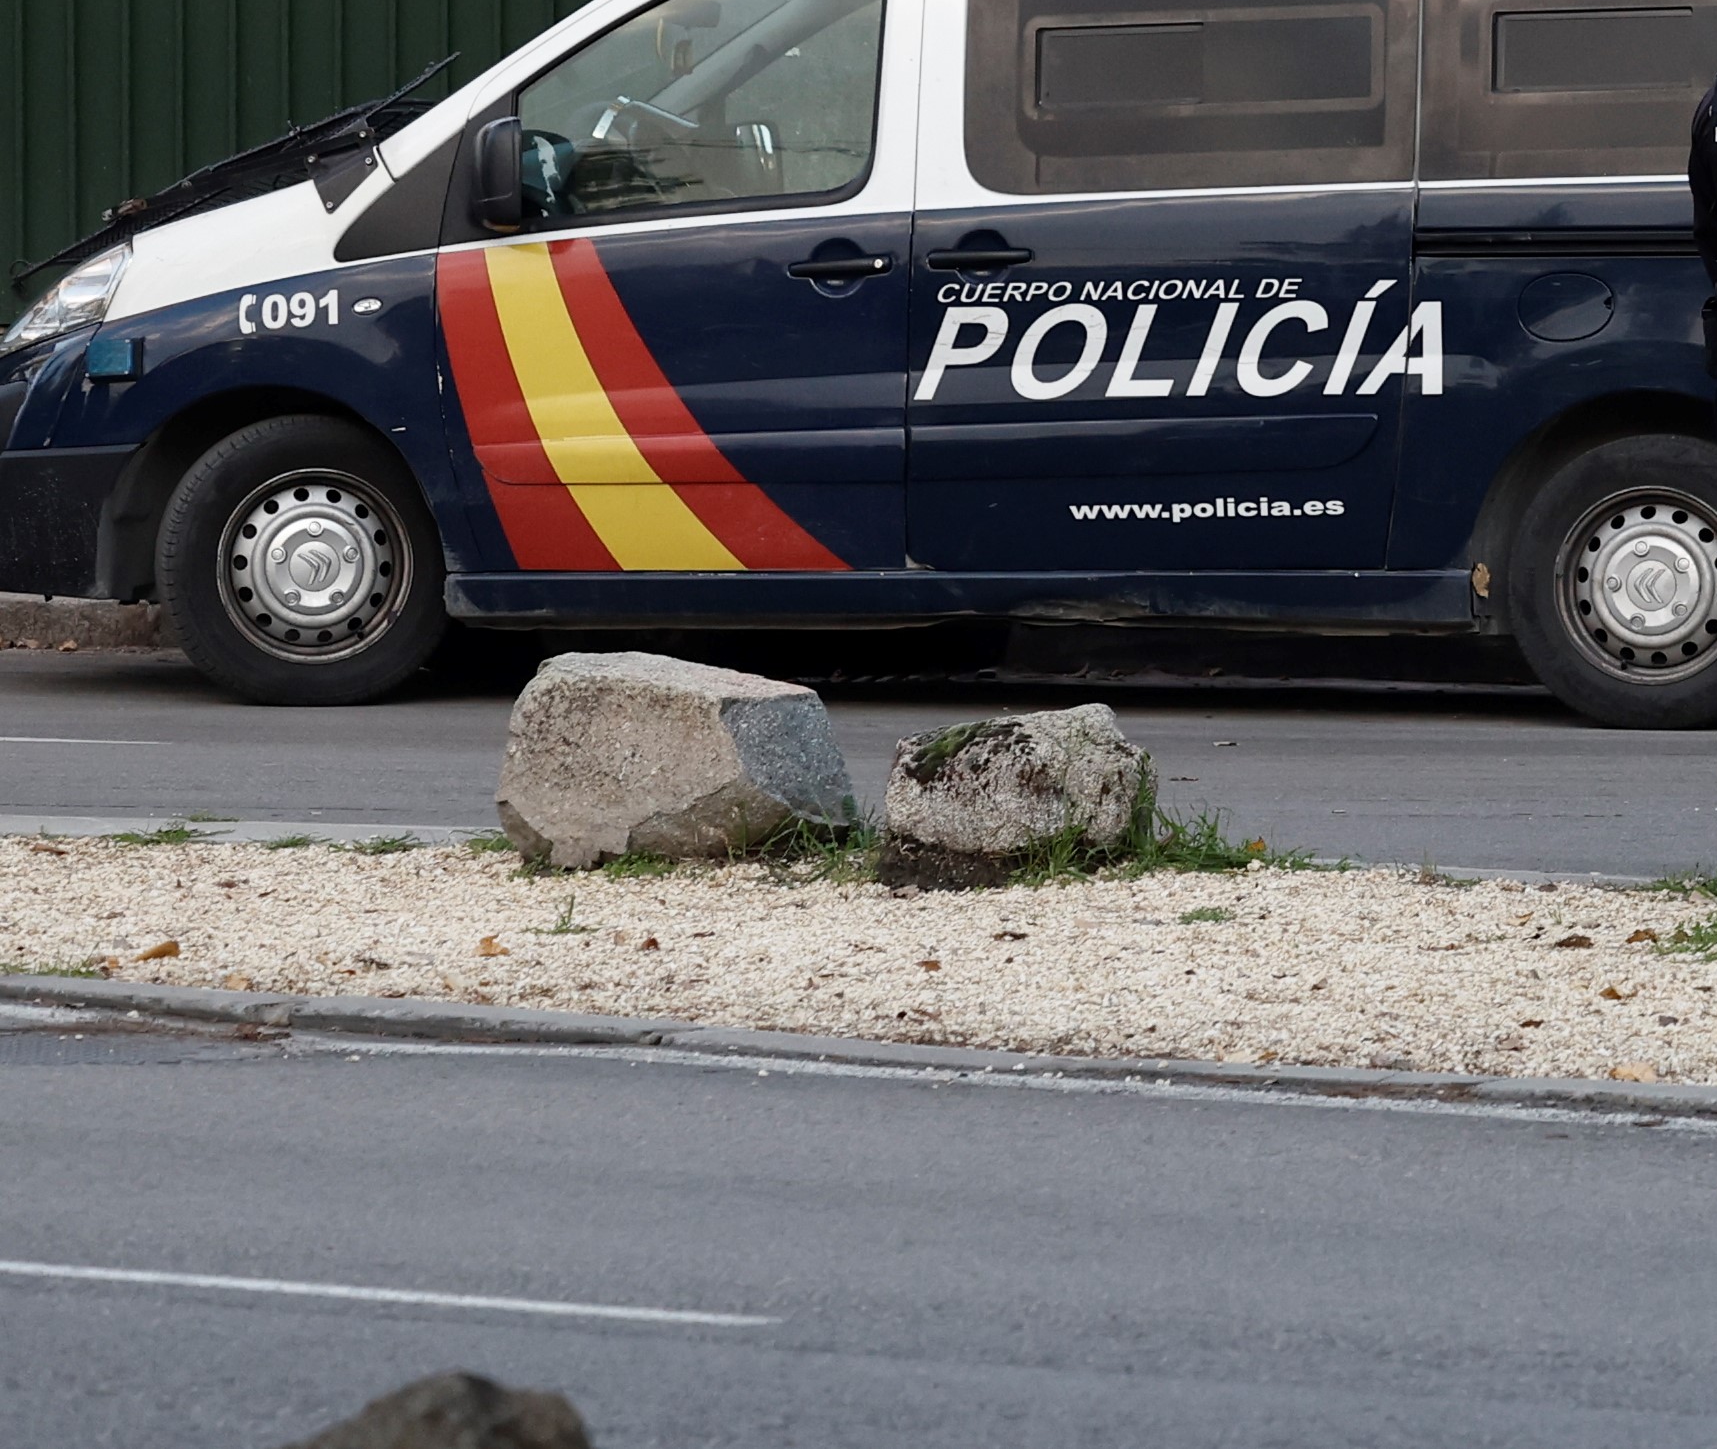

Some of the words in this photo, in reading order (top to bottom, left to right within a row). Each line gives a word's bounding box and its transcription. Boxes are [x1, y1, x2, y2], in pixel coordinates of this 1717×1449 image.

[937, 280, 1073, 303] CUERPO
[1080, 279, 1245, 302] NACIONAL
[1255, 278, 1303, 299] DE
[261, 289, 339, 330] 091
[913, 279, 1444, 401] POLICÍA
[1069, 497, 1345, 523] www.policia.es
